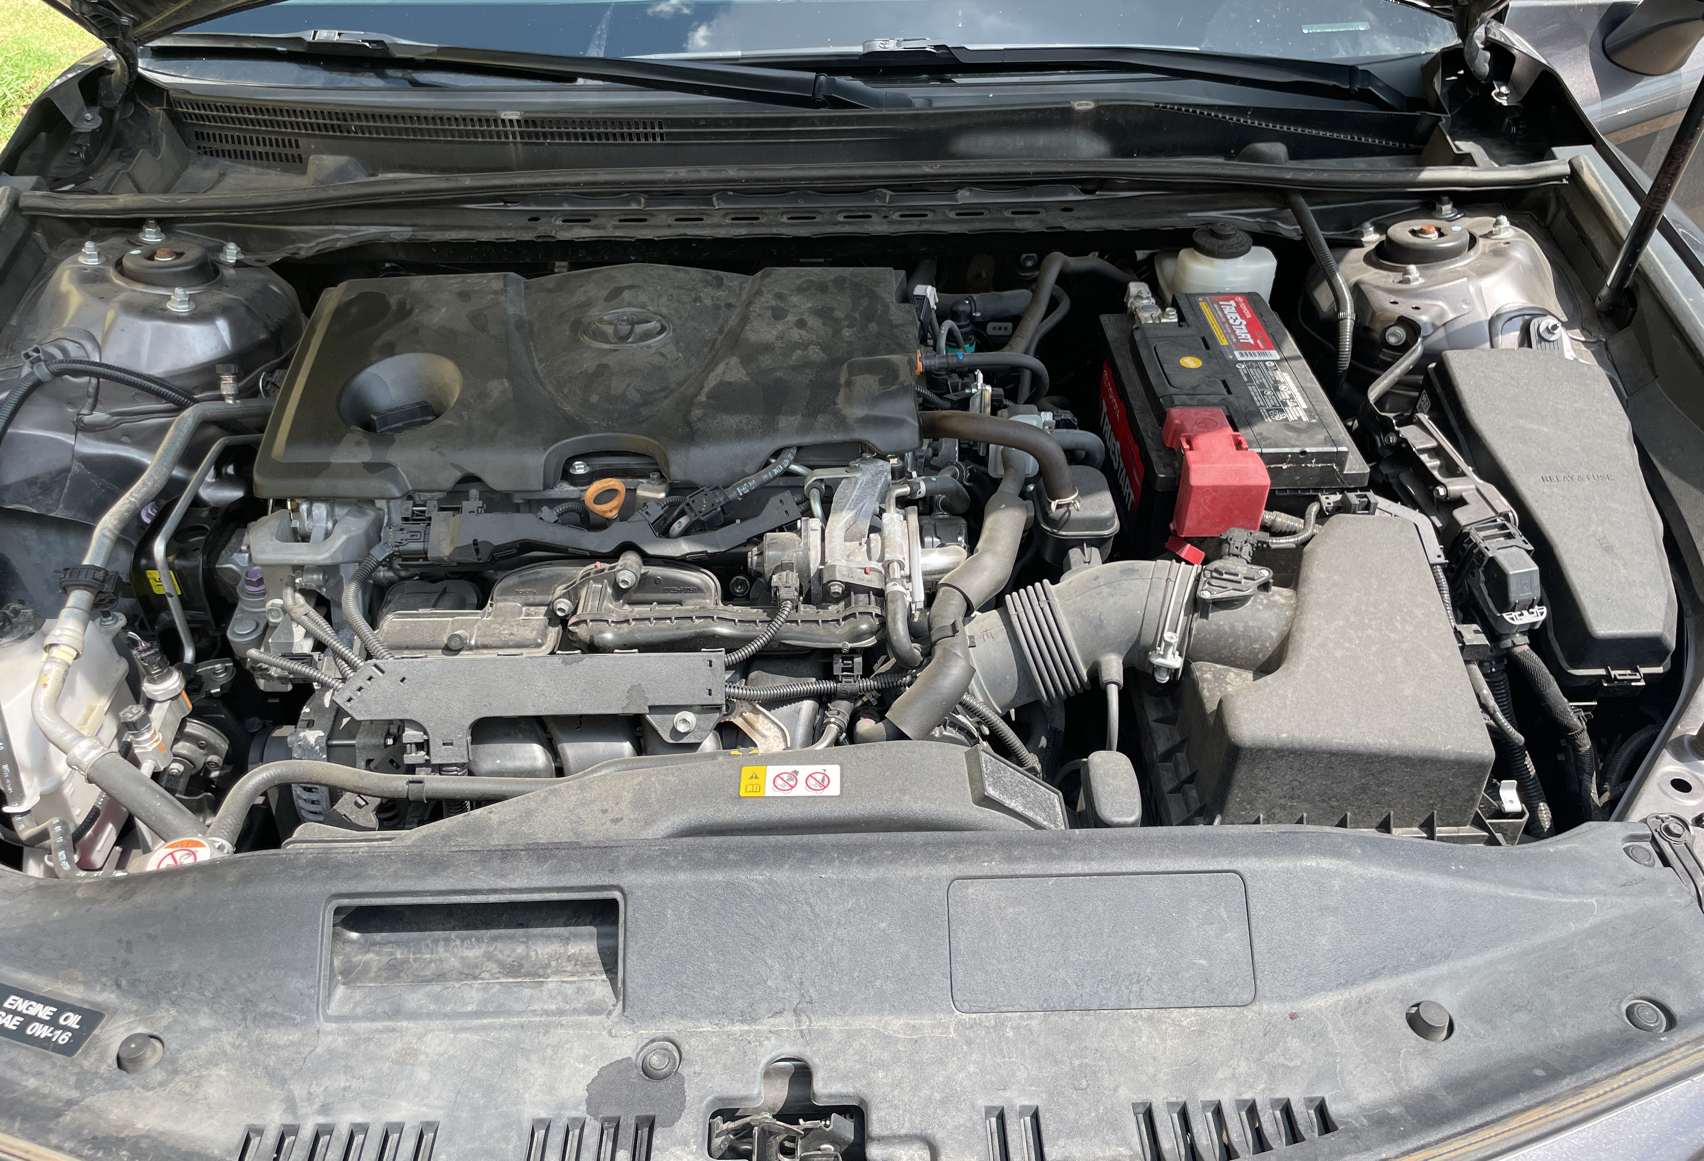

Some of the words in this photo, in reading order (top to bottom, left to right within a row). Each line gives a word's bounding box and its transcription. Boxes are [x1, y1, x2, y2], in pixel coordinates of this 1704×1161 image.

[1541, 474, 1575, 483] RELAY
[1587, 473, 1615, 482] FUSE
[3, 994, 57, 1021] ENGINE
[58, 1011, 83, 1029] OIL
[26, 1021, 73, 1045] 0W-16
